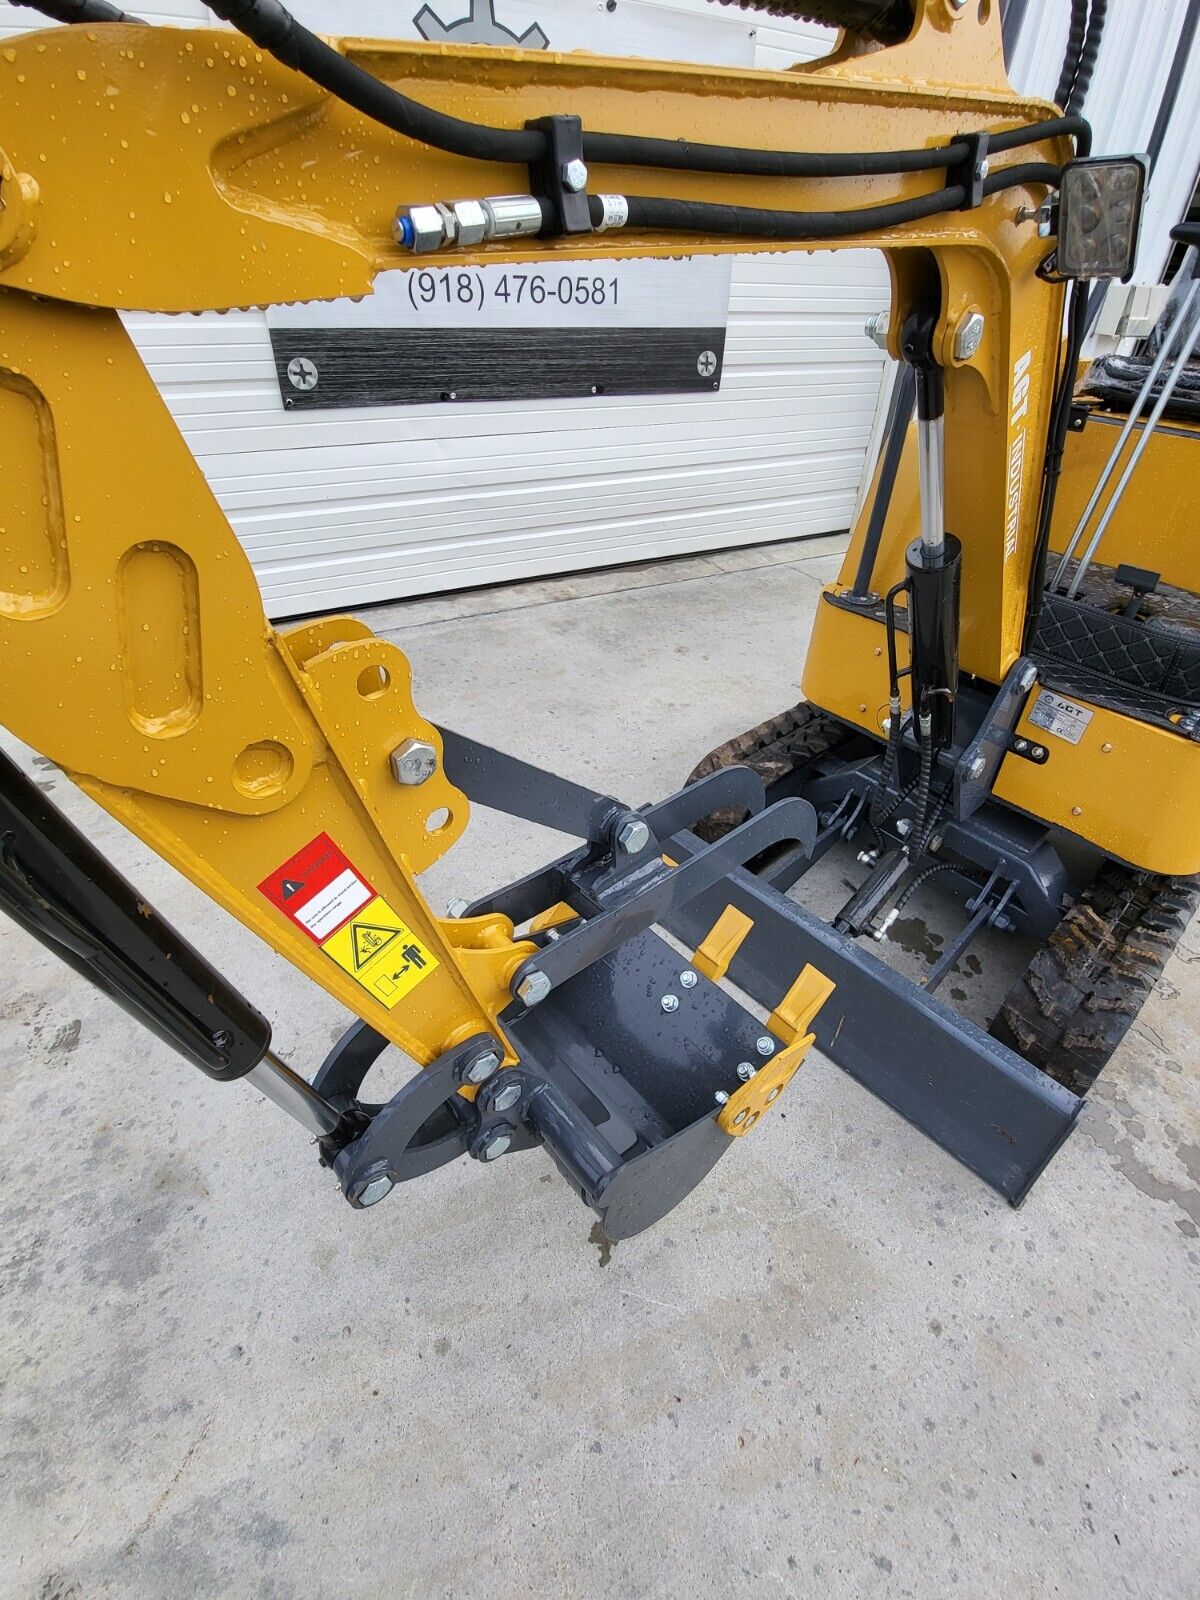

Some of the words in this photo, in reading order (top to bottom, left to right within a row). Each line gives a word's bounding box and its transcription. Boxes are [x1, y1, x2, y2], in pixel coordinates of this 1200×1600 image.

[408, 271, 485, 311] (918)
[494, 274, 618, 305] 476-0581
[1011, 350, 1032, 427] AGT
[1005, 432, 1023, 561] INDUSTRIAL
[1057, 702, 1083, 717] AGT
